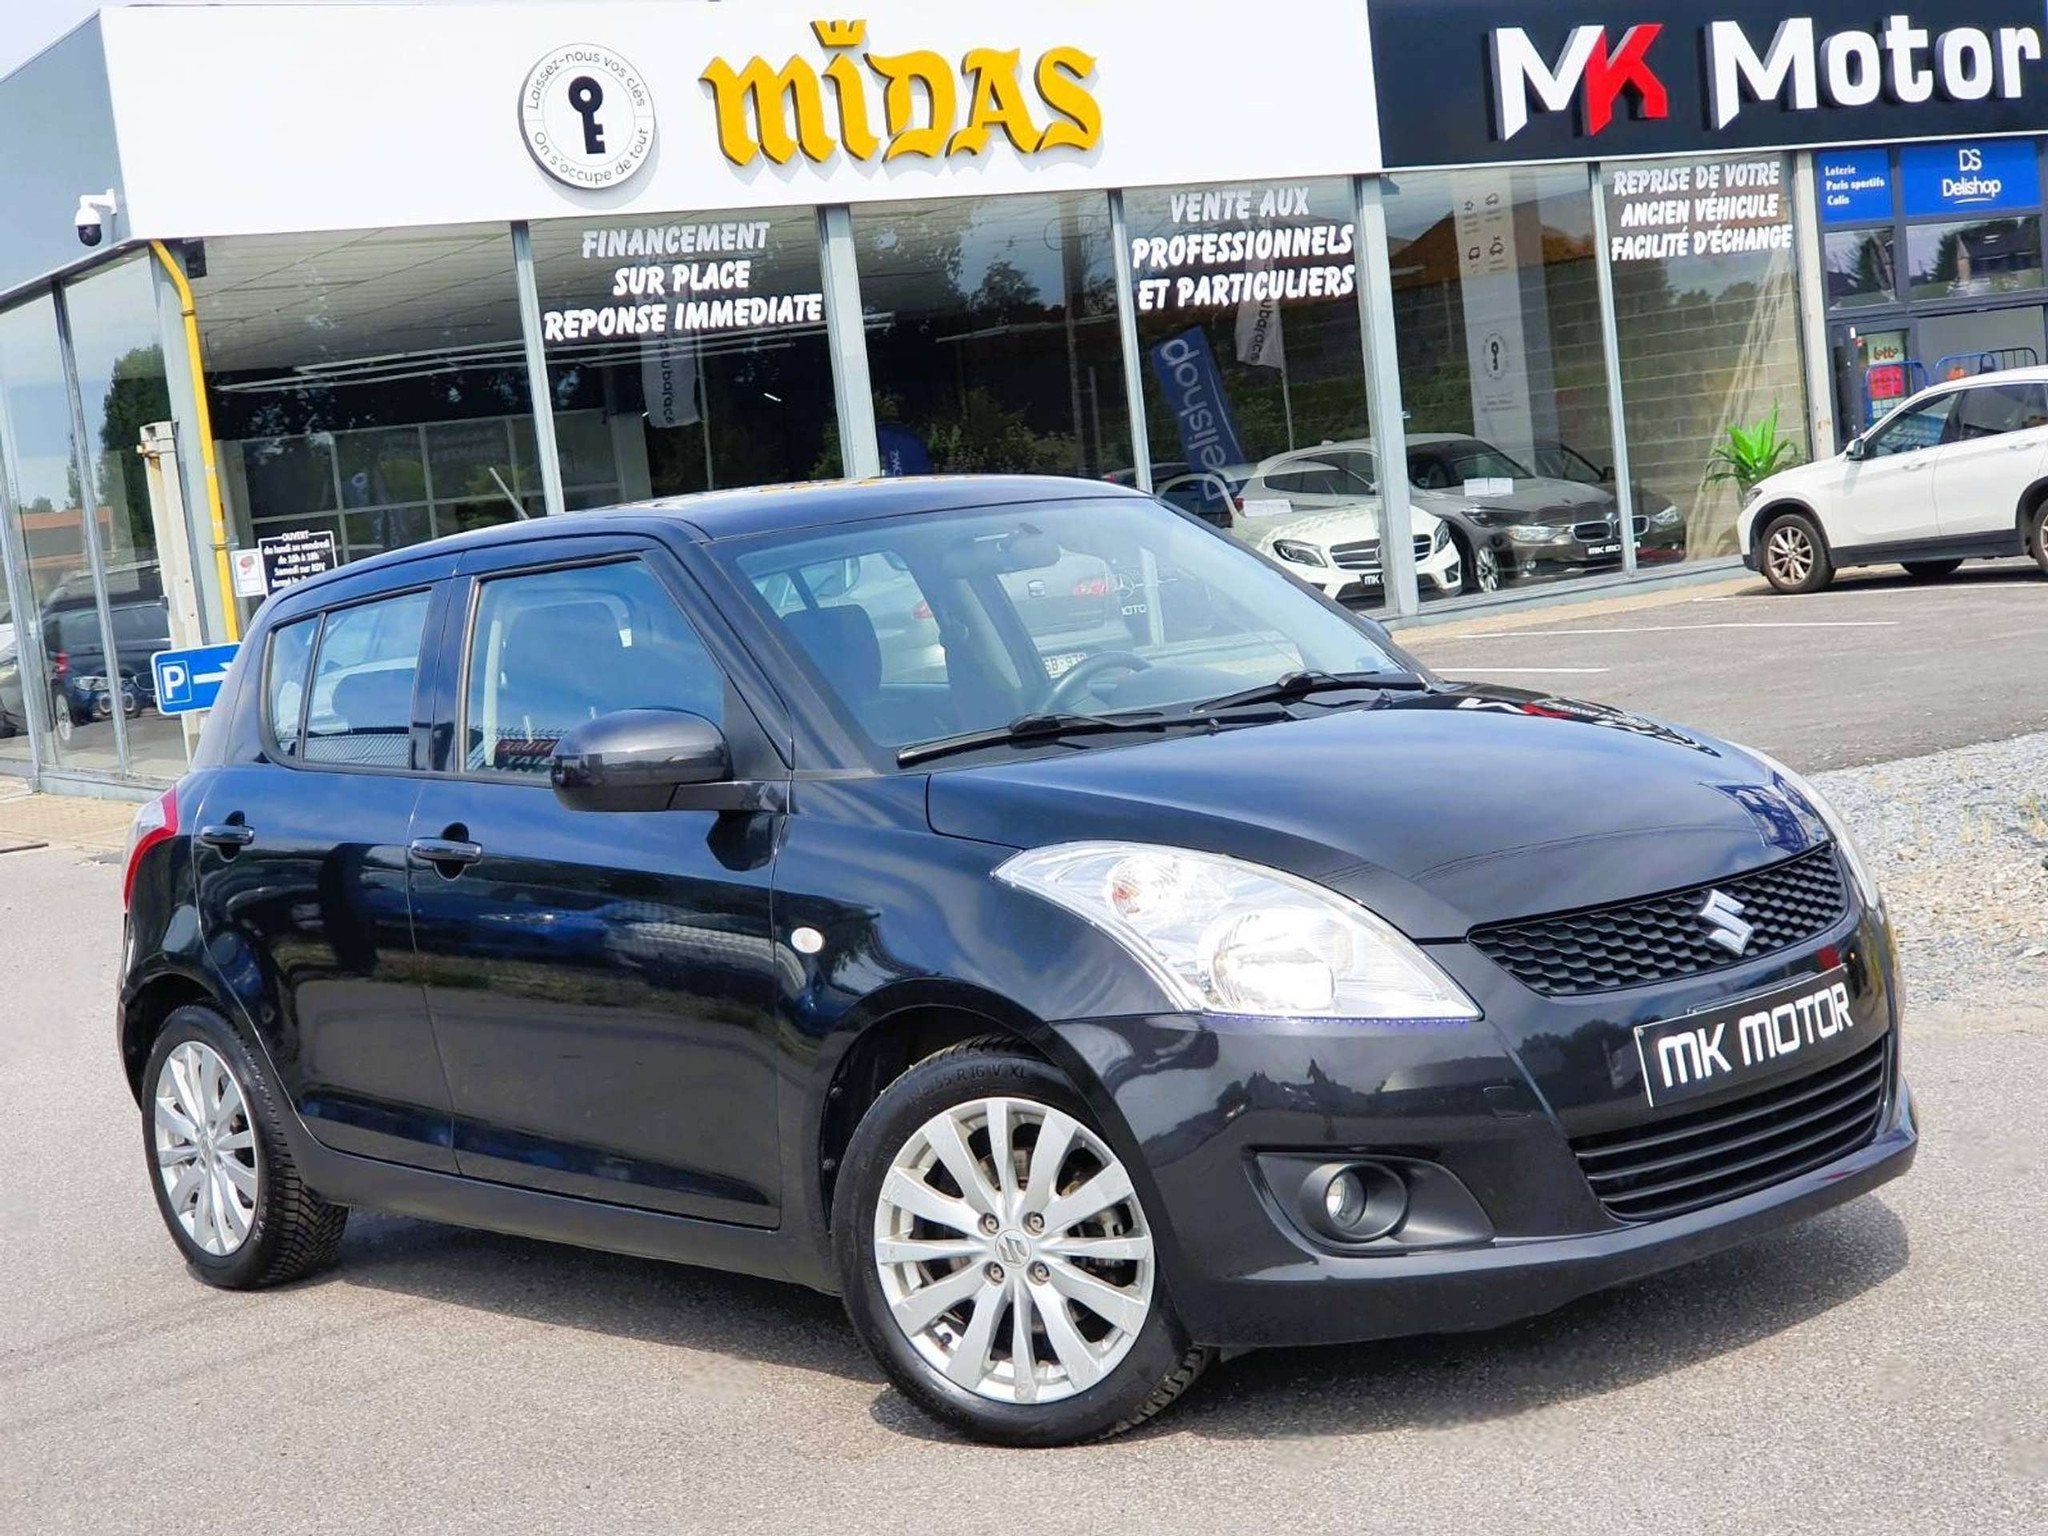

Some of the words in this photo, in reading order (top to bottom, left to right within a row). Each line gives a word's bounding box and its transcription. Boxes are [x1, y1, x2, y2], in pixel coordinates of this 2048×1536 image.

[526, 50, 600, 110] Laissez-nous
[604, 57, 627, 78] vos
[1490, 23, 1668, 141] MK
[1703, 15, 2042, 131] Motor
[534, 131, 551, 156] On
[550, 155, 612, 185] s'occupe
[615, 158, 632, 175] de
[629, 128, 649, 159] tout
[1825, 164, 1856, 176] Loterie
[1958, 149, 1983, 171] DS
[1613, 167, 1691, 197] REPRISE
[1695, 165, 1720, 190] DE
[1724, 161, 1781, 187] VOTRE
[1942, 176, 2001, 197] Delishop
[1170, 188, 1250, 223] VENTE
[1259, 186, 1310, 218] AUX
[1620, 199, 1691, 228] ANCIEN
[1694, 191, 1779, 223] VÉHICULE
[582, 221, 770, 259] FINANCEMENT
[1132, 223, 1355, 269] PROFESSIONNELS
[1611, 226, 1689, 262] FACILITÉ
[1693, 223, 1793, 255] D'ÉCHANGE
[612, 264, 665, 297] SUR
[672, 260, 751, 292] PLACE
[1138, 279, 1170, 311] ET
[1176, 264, 1356, 308] PARTICULIERS
[543, 304, 668, 342] REPONSE
[674, 293, 823, 331] IMMEDIATE
[162, 665, 185, 699] P
[1657, 1023, 1732, 1088] MK
[1738, 981, 1853, 1066] MOTOR
